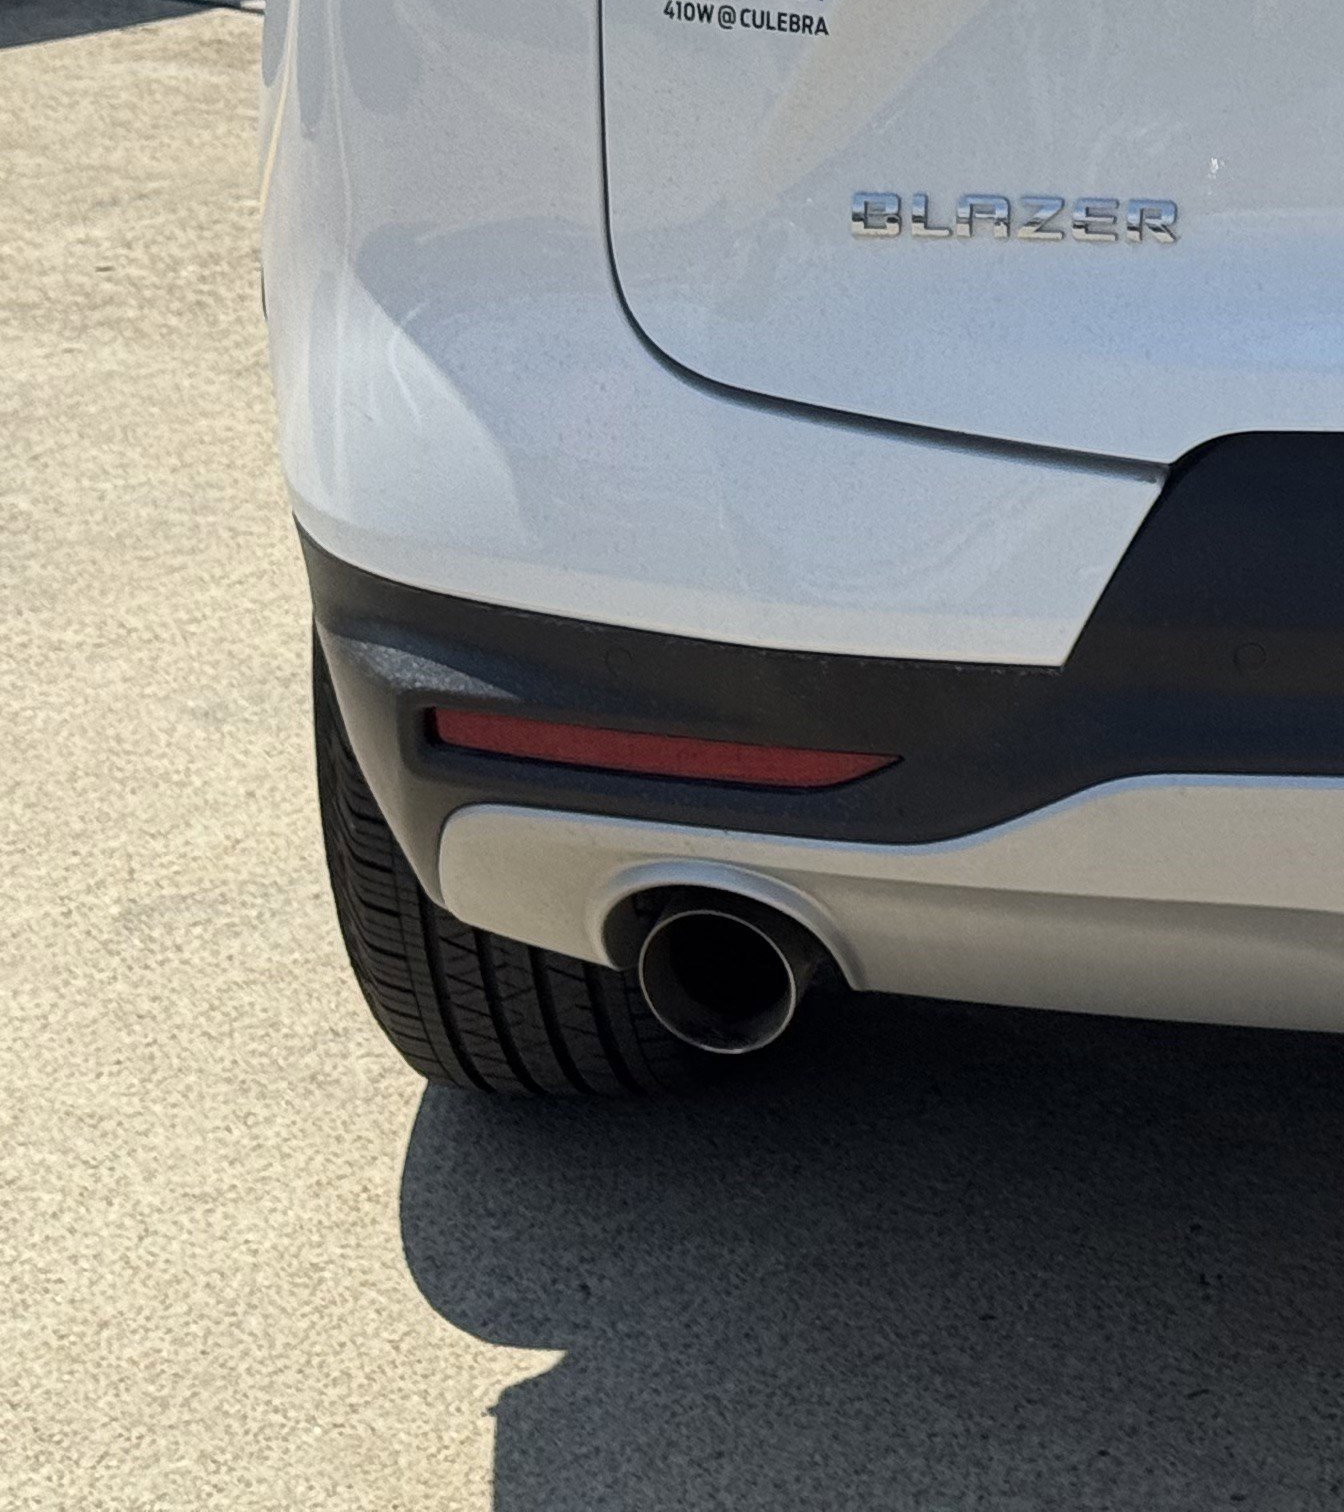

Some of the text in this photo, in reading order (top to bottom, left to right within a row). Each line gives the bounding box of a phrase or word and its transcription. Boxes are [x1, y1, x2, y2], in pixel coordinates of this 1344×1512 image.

[663, 0, 830, 36] 410W @ CULEBRA
[851, 191, 1182, 242] BLAZER
